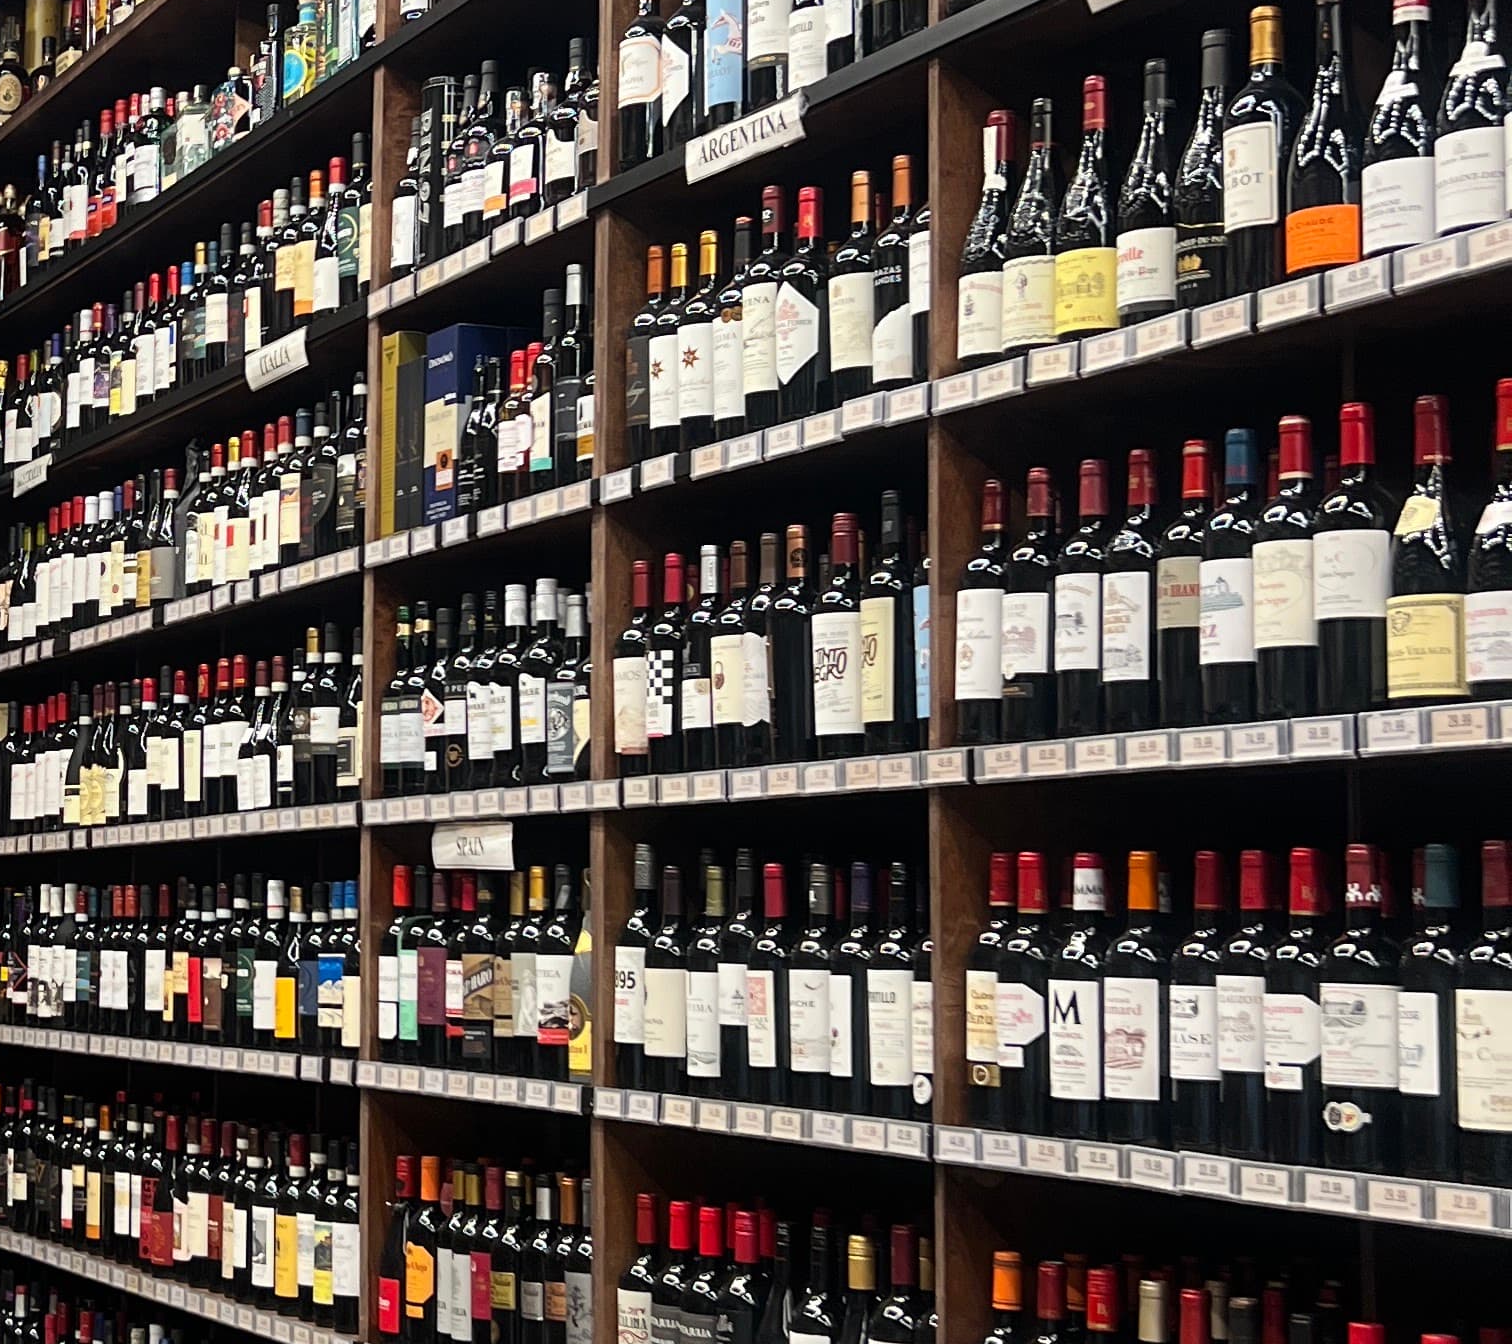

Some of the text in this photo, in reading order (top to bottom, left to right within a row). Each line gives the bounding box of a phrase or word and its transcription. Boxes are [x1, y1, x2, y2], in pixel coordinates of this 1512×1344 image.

[698, 113, 789, 167] ARGENTINA
[260, 346, 290, 376] ITALIA
[456, 836, 485, 857] SPAIN
[1053, 989, 1082, 1026] M
